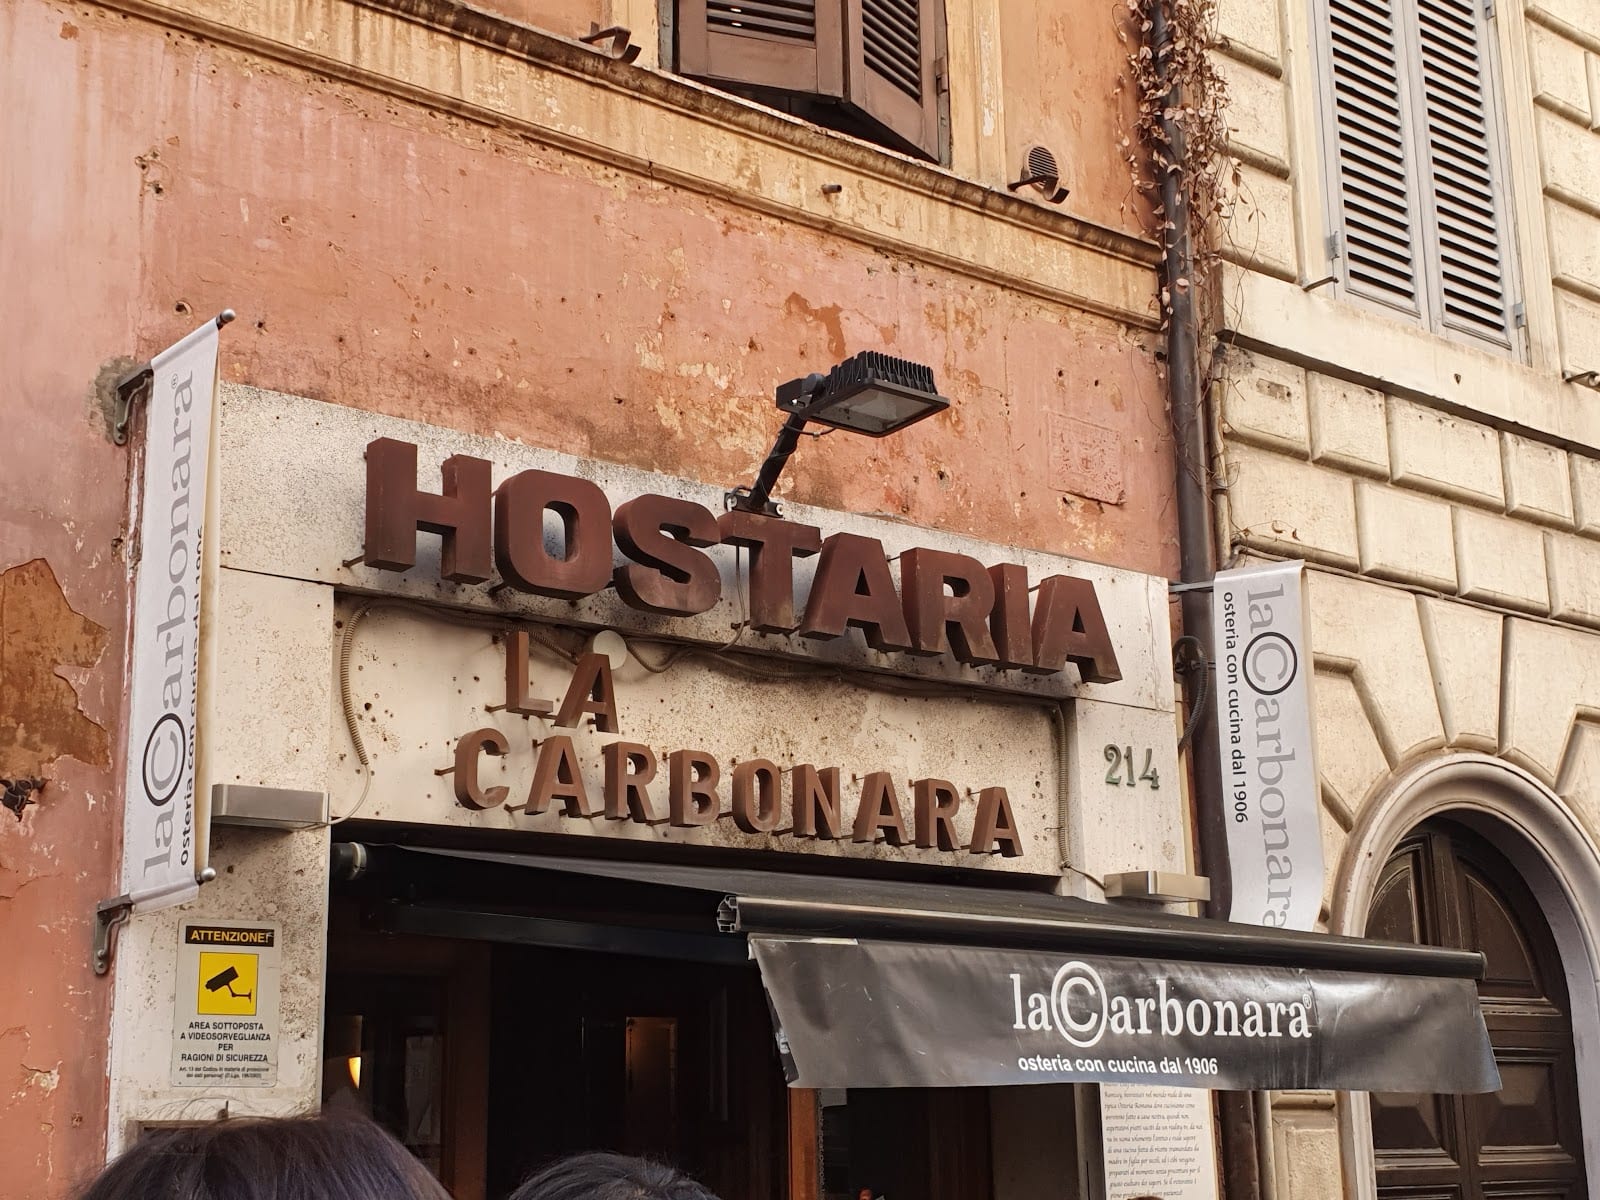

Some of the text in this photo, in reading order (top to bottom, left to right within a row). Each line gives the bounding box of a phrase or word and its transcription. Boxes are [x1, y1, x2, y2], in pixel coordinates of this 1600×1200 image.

[365, 437, 1122, 684] HOSTARIA
[505, 630, 619, 734] LA
[1223, 592, 1249, 823] osteria con cucina dal 1906
[1103, 743, 1160, 790] 214
[453, 728, 1024, 857] CARBONARA
[190, 929, 269, 943] ATTENZIONE!
[180, 1032, 271, 1041] A VIDEOSORVEGLIANZA
[189, 1022, 264, 1031] AREA SOTTOPOSTA
[218, 1043, 234, 1051] PER
[181, 1054, 268, 1062] RAGIONI DI SICUREZZA
[1018, 1054, 1218, 1075] osteria con cucina dal 1906
